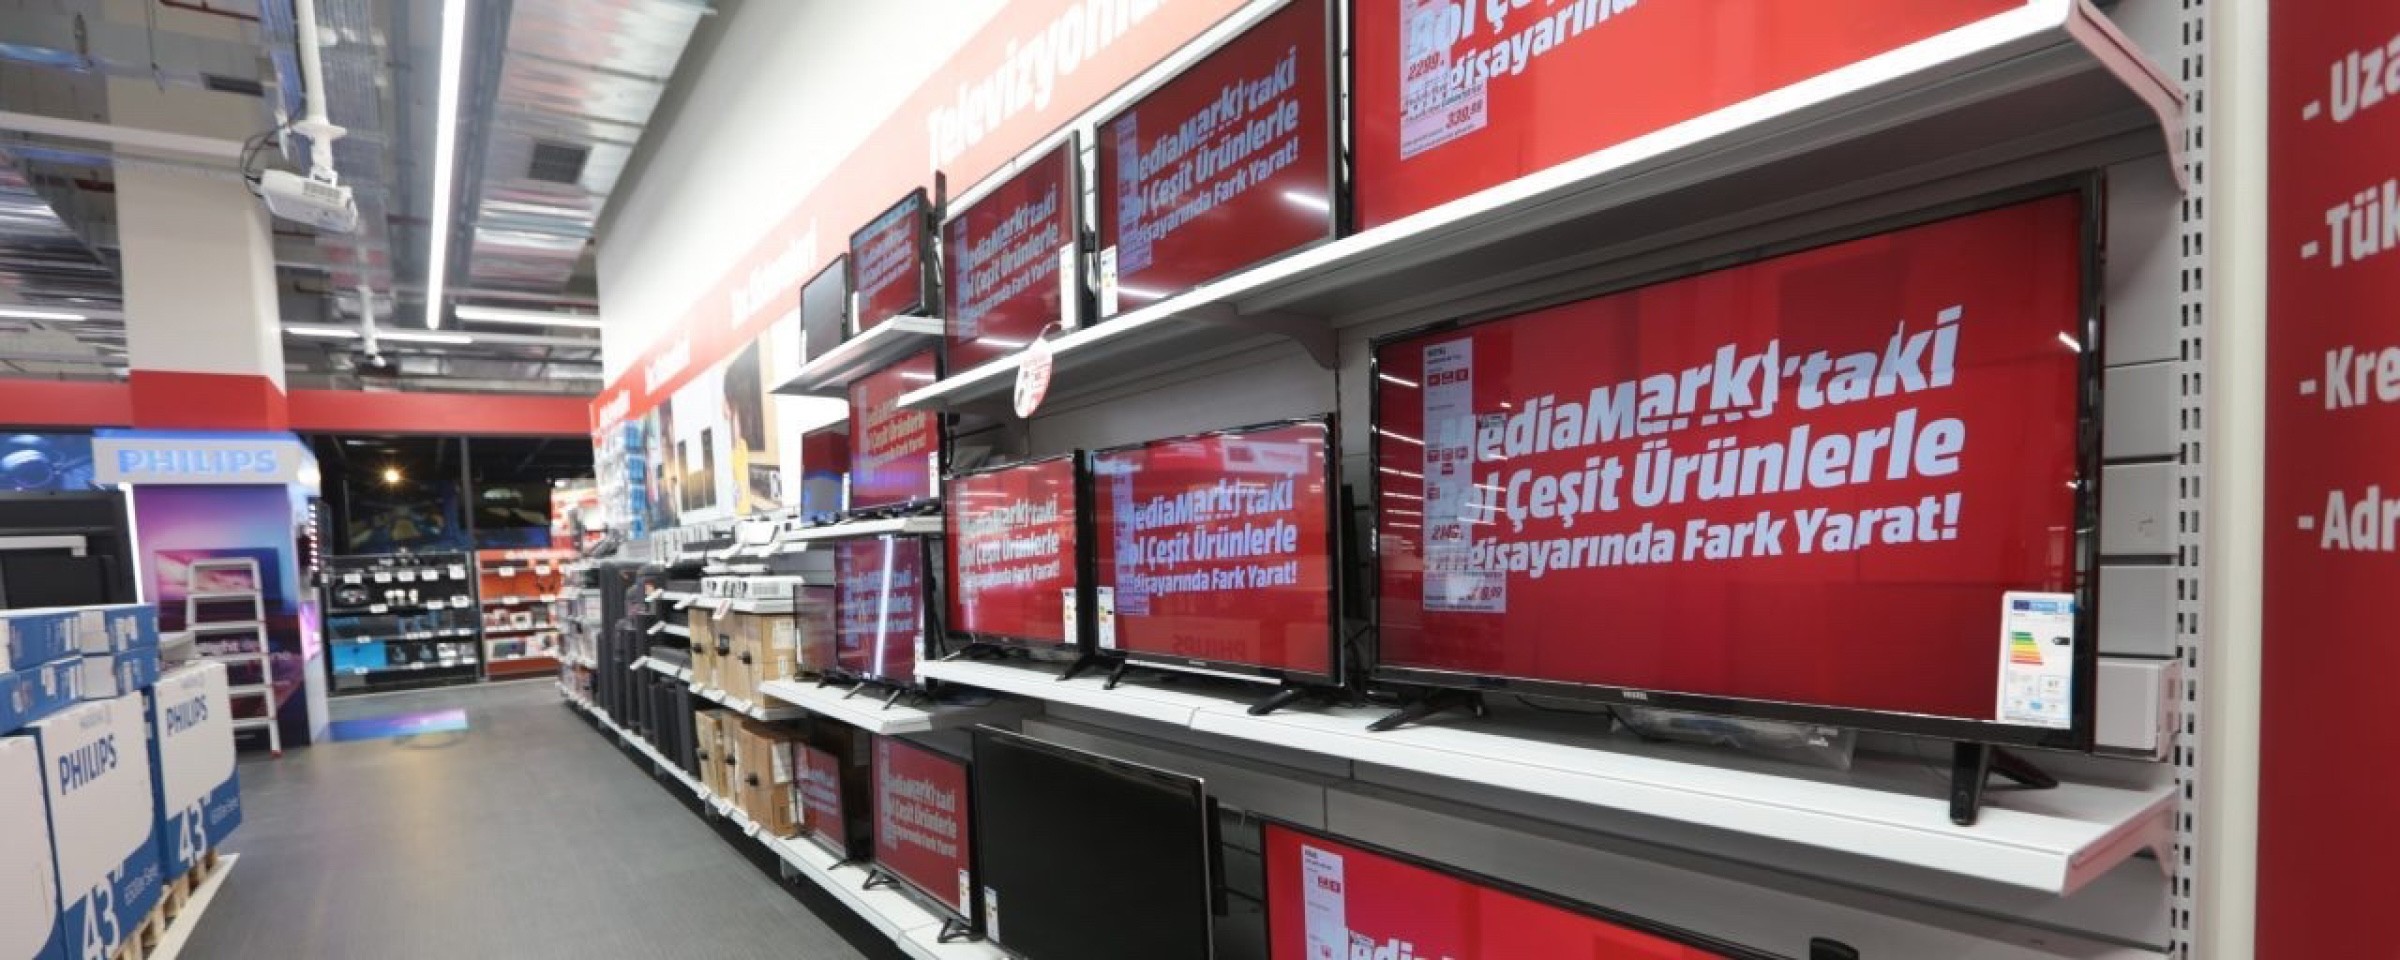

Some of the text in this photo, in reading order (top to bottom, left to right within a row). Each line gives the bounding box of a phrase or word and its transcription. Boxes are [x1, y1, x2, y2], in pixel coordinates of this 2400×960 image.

[119, 449, 278, 474] PHILIPS
[1506, 453, 1626, 532] Çeşit
[1631, 407, 1966, 509] Ürünlerle
[1193, 518, 1297, 560] Ürünlerle
[1683, 511, 1788, 561] Fark
[1793, 492, 1963, 555] Yarat!
[1211, 566, 1246, 590] Fark
[1247, 561, 1297, 588] Yarat!
[166, 695, 208, 736] PHILIPS
[58, 734, 117, 796] PHILIPS
